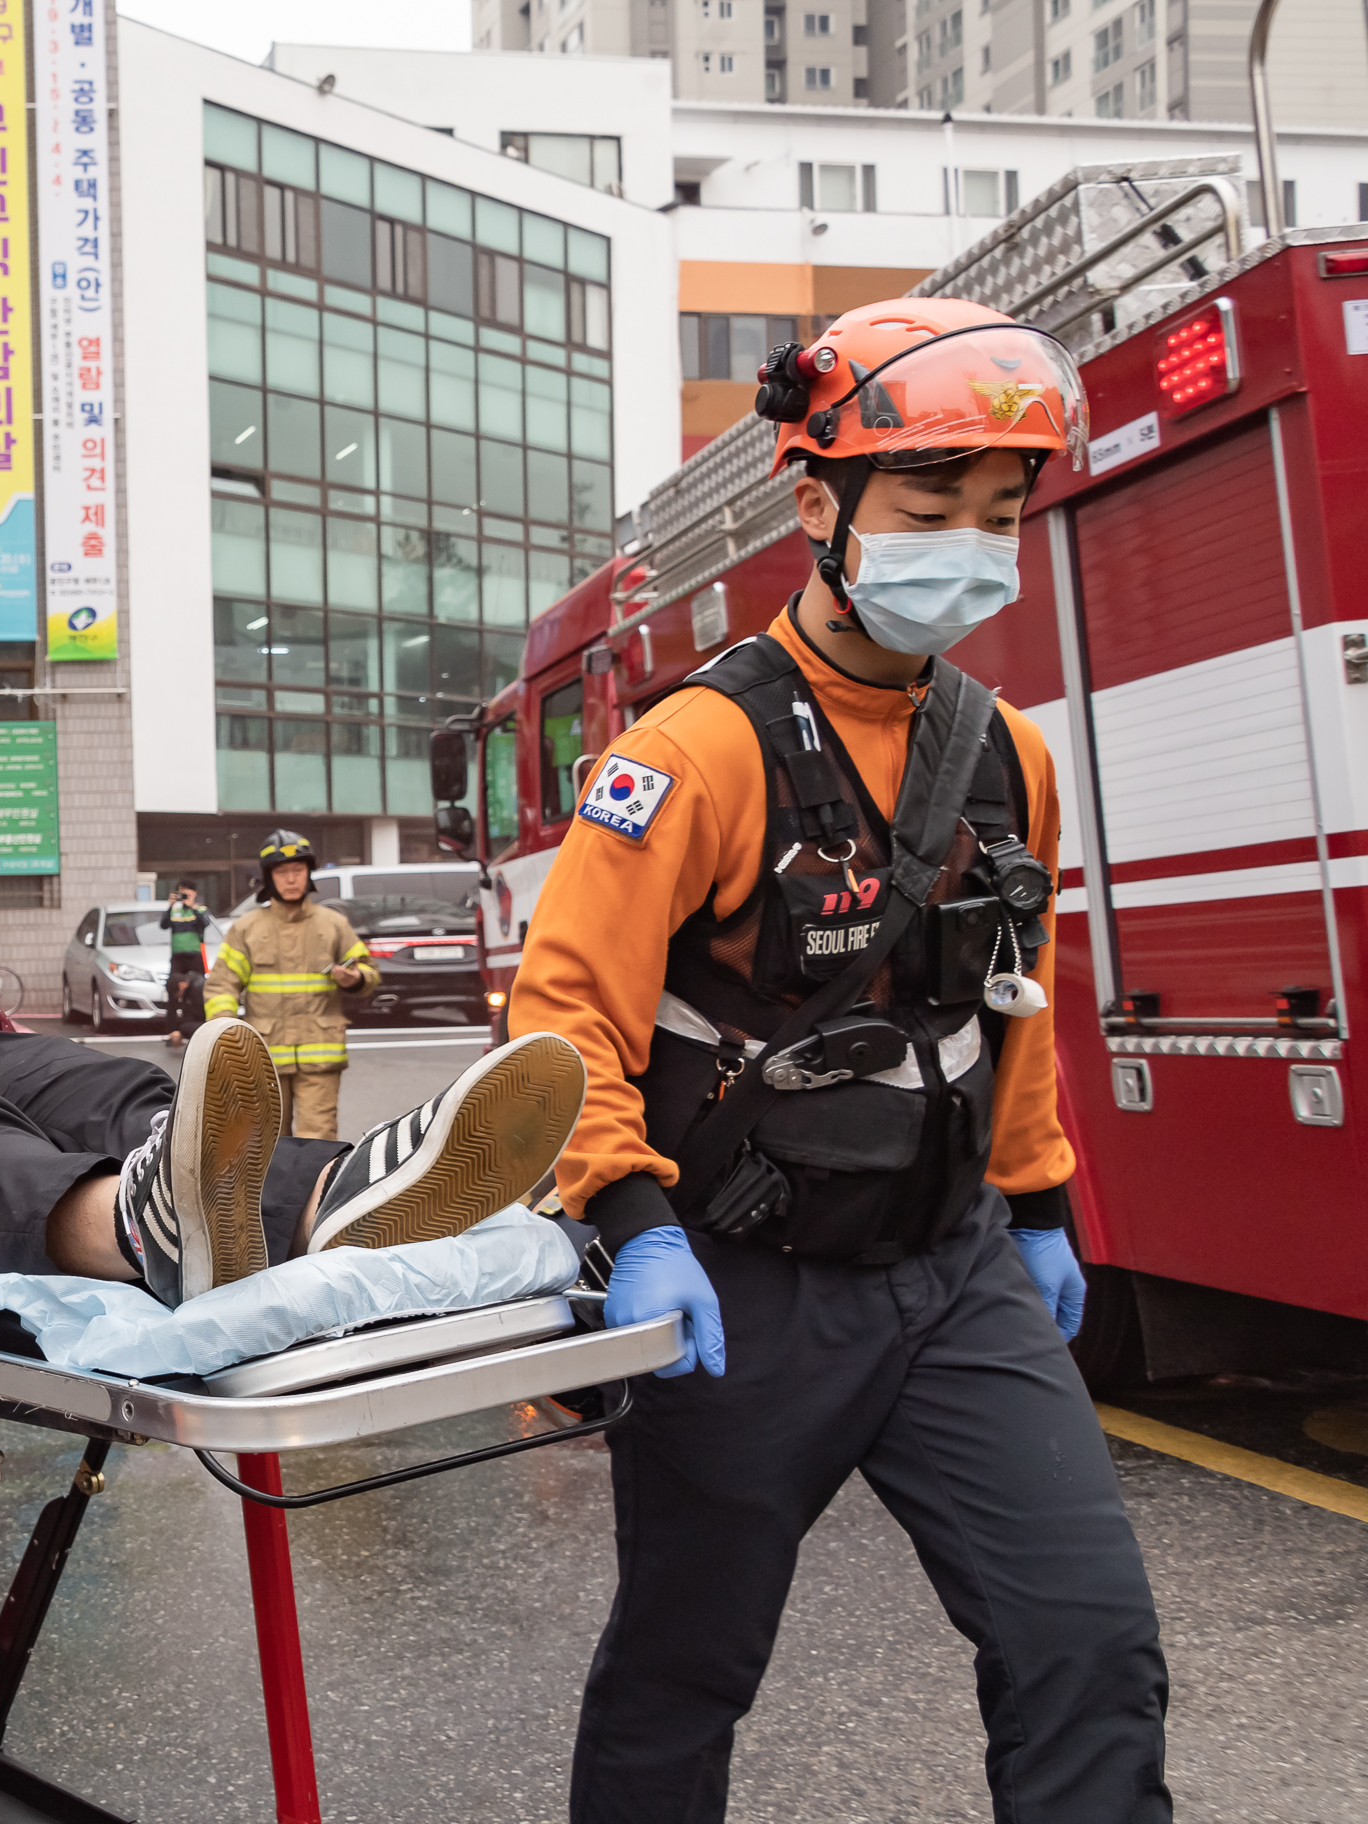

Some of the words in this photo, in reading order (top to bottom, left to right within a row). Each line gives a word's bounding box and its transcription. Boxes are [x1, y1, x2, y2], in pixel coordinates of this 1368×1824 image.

[77, 336, 104, 391] 열람
[80, 401, 104, 428] 및
[81, 437, 106, 492] 의견
[80, 503, 106, 558] 제출
[583, 804, 634, 834] KOREA
[820, 877, 881, 915] 119
[806, 928, 846, 955] SEOUL
[847, 924, 870, 951] FIRE
